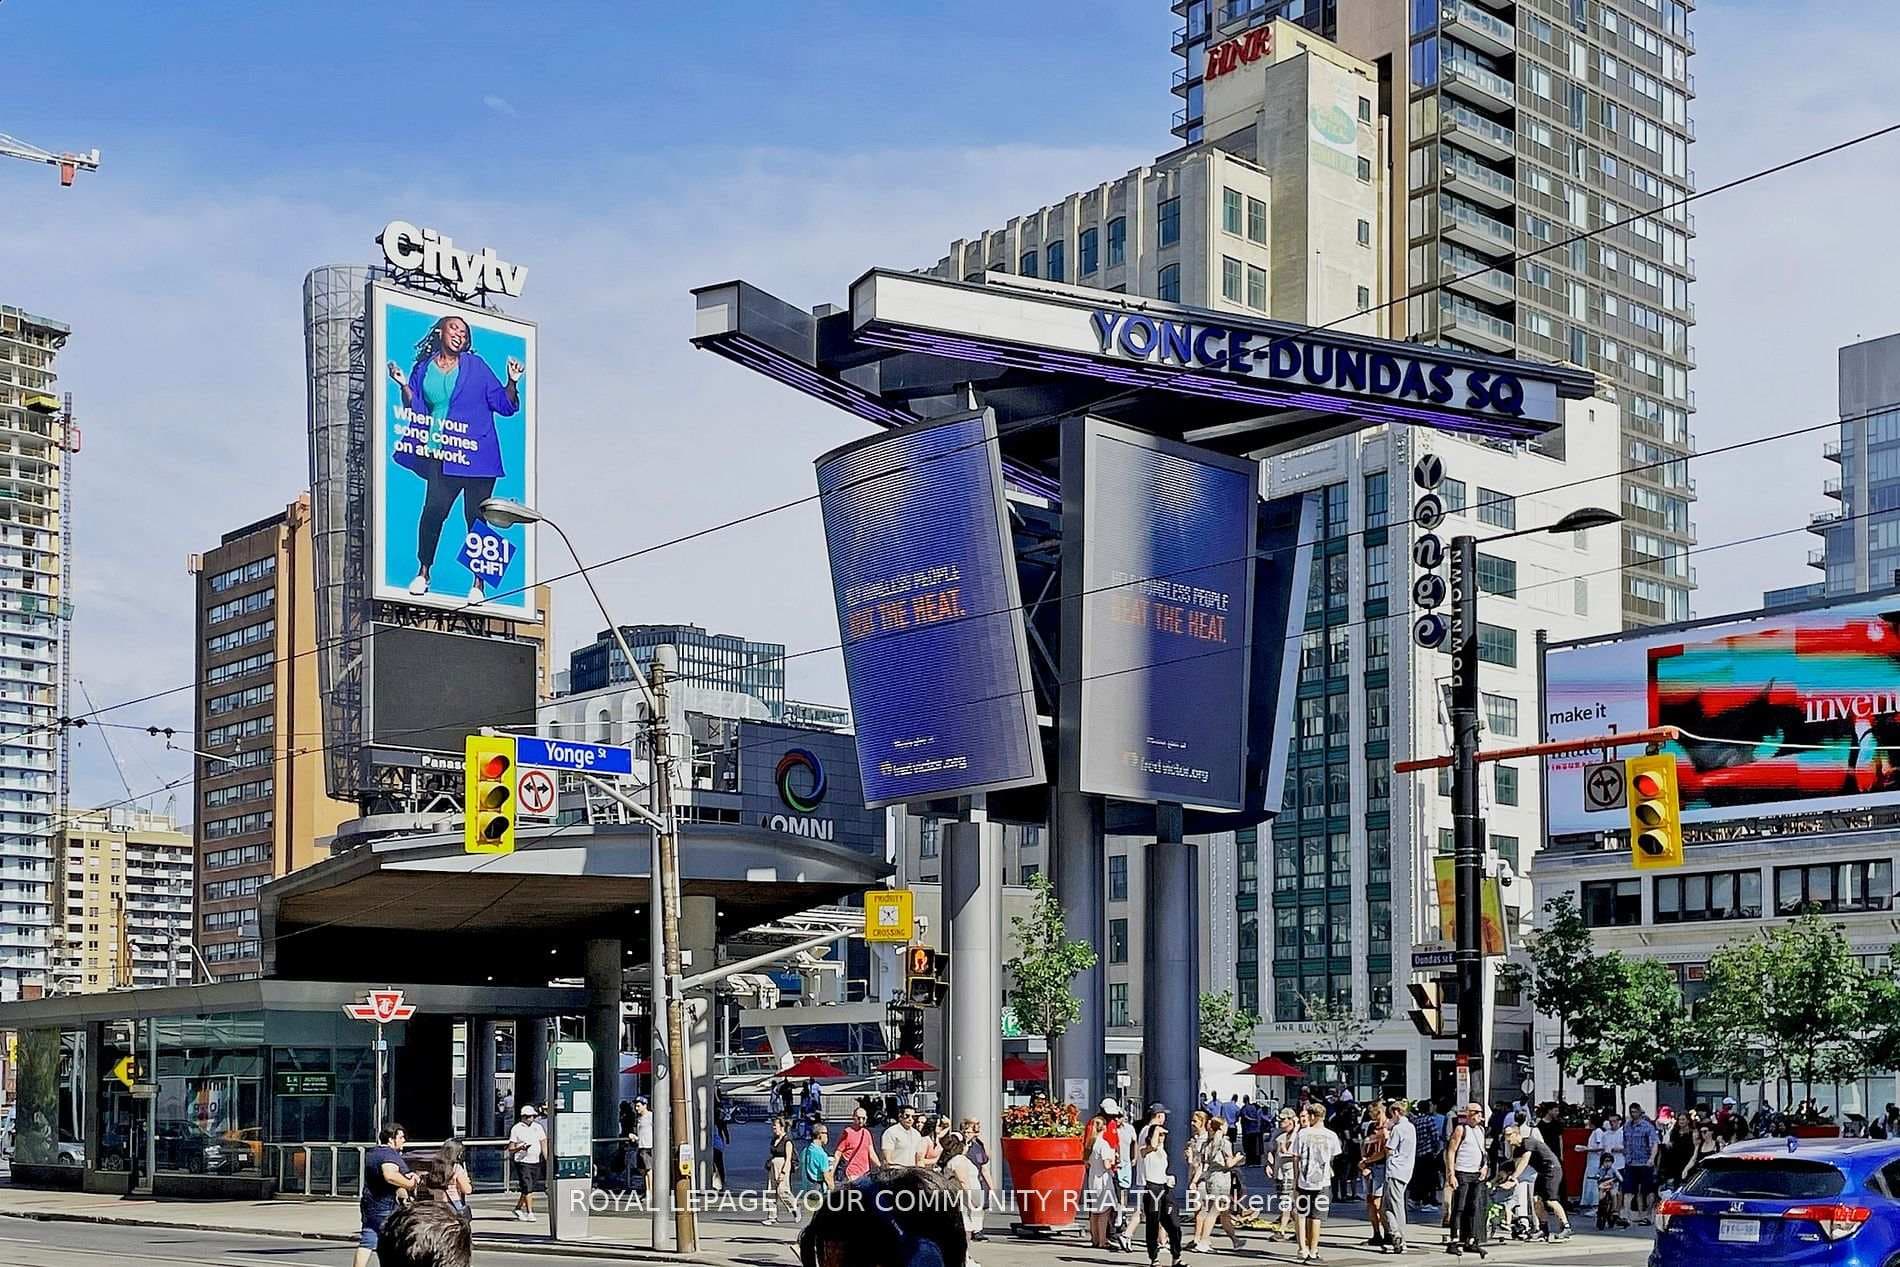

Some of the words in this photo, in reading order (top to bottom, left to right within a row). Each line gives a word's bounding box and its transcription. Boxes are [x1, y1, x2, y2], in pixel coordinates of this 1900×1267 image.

[1204, 25, 1272, 80] HNR
[383, 220, 528, 297] Citytv
[1089, 310, 1454, 404] YONGE-DUNDAS
[1466, 370, 1526, 417] SQ
[393, 405, 433, 426] When
[438, 418, 469, 434] your
[393, 423, 430, 443] song
[431, 432, 478, 451] comes
[394, 440, 413, 453] on
[415, 443, 430, 458] at
[433, 448, 471, 466] work.
[465, 532, 509, 563] 98.1
[469, 558, 504, 576] CHFI
[1192, 586, 1230, 612] PEOPLE
[1152, 602, 1185, 634] THE
[1187, 610, 1227, 644] HEAT.
[1451, 550, 1464, 688] DOWNTOWN
[1550, 706, 1593, 725] make
[1595, 702, 1607, 719] it
[1803, 690, 1900, 724] inven
[545, 741, 595, 769] Yonge
[597, 748, 607, 759] St
[770, 814, 834, 841] OMNI
